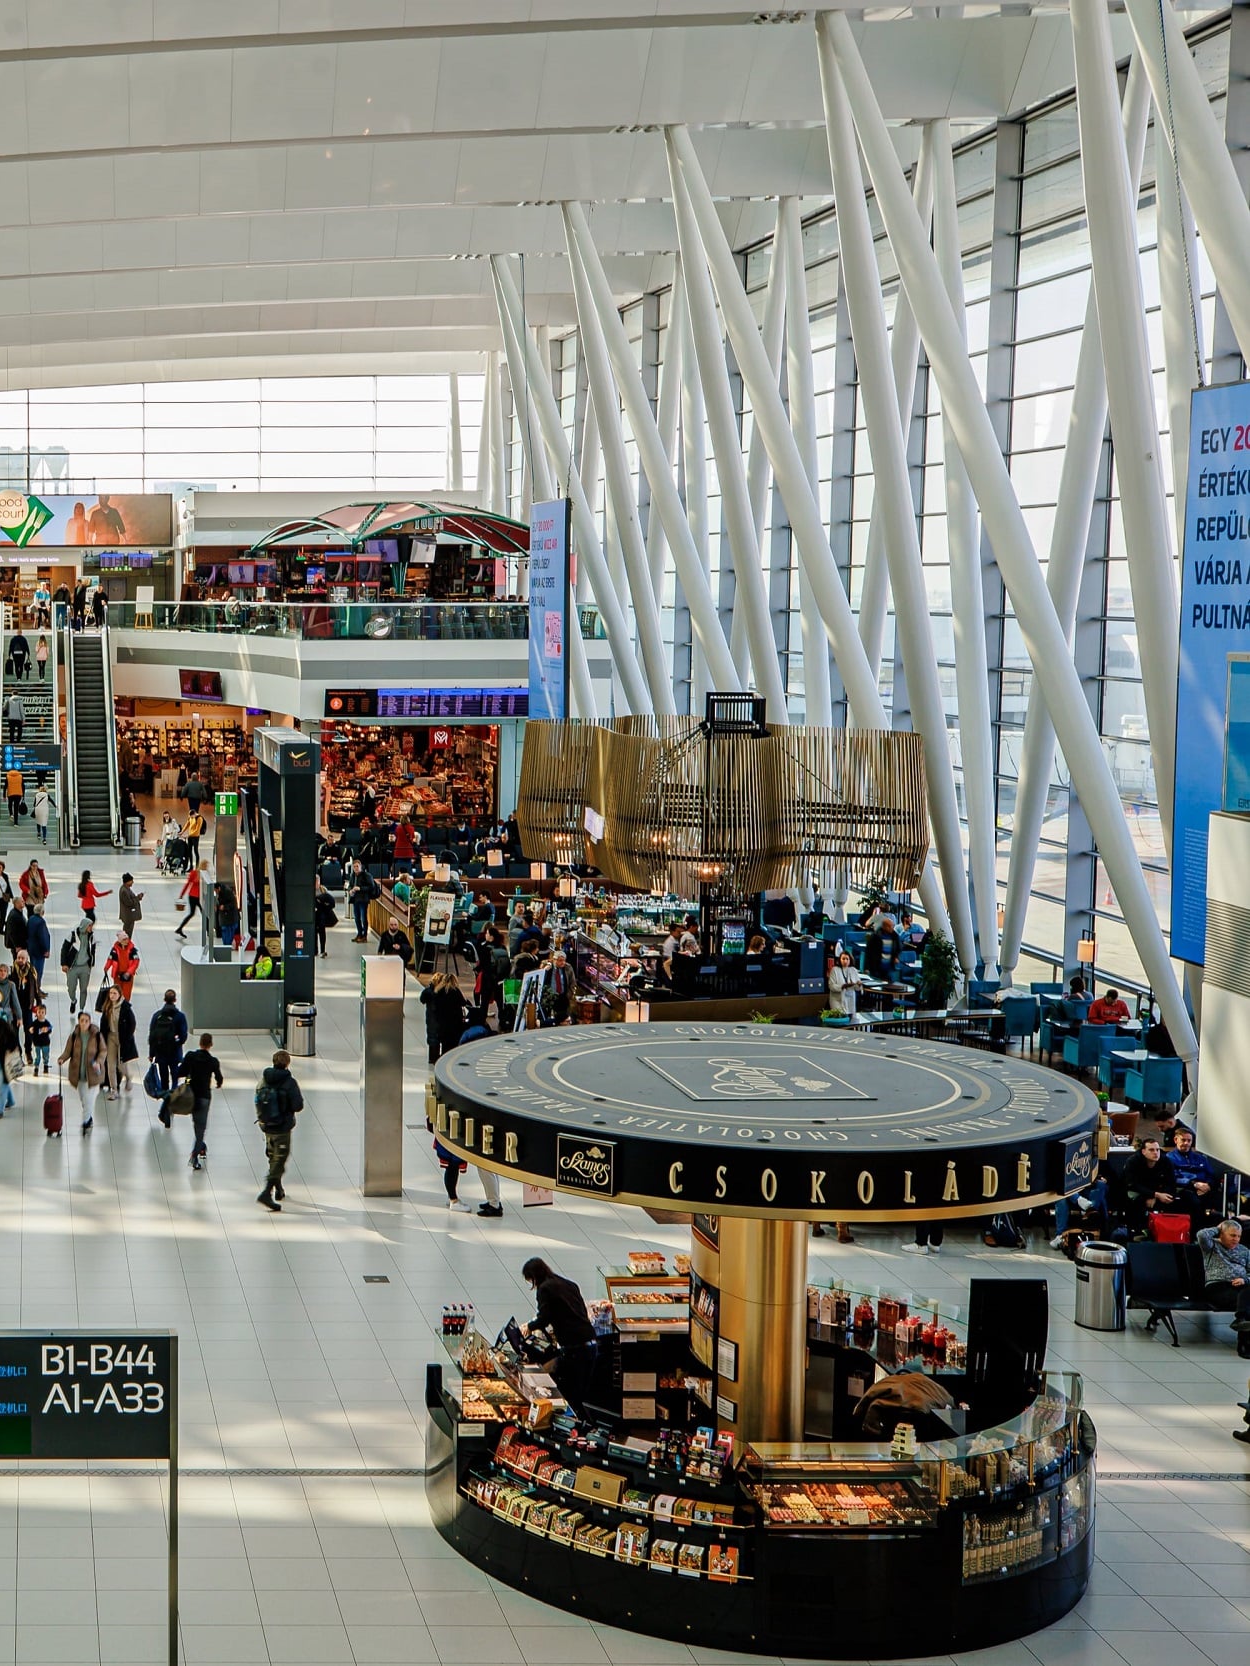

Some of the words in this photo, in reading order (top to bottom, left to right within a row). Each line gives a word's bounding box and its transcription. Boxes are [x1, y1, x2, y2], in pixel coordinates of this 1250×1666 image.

[1201, 427, 1231, 454] EGY
[1195, 554, 1242, 585] VÁRJA
[293, 759, 310, 767] bud
[675, 1027, 866, 1045] CHOCOLATIER
[430, 1095, 519, 1163] ATIER
[619, 1115, 849, 1141] CHOCOLATIER
[560, 1151, 611, 1186] Szamos
[668, 1152, 1031, 1205] CSOKOLÁDÉ
[41, 1344, 156, 1375] B1-B44
[42, 1383, 164, 1414] A1-A33
